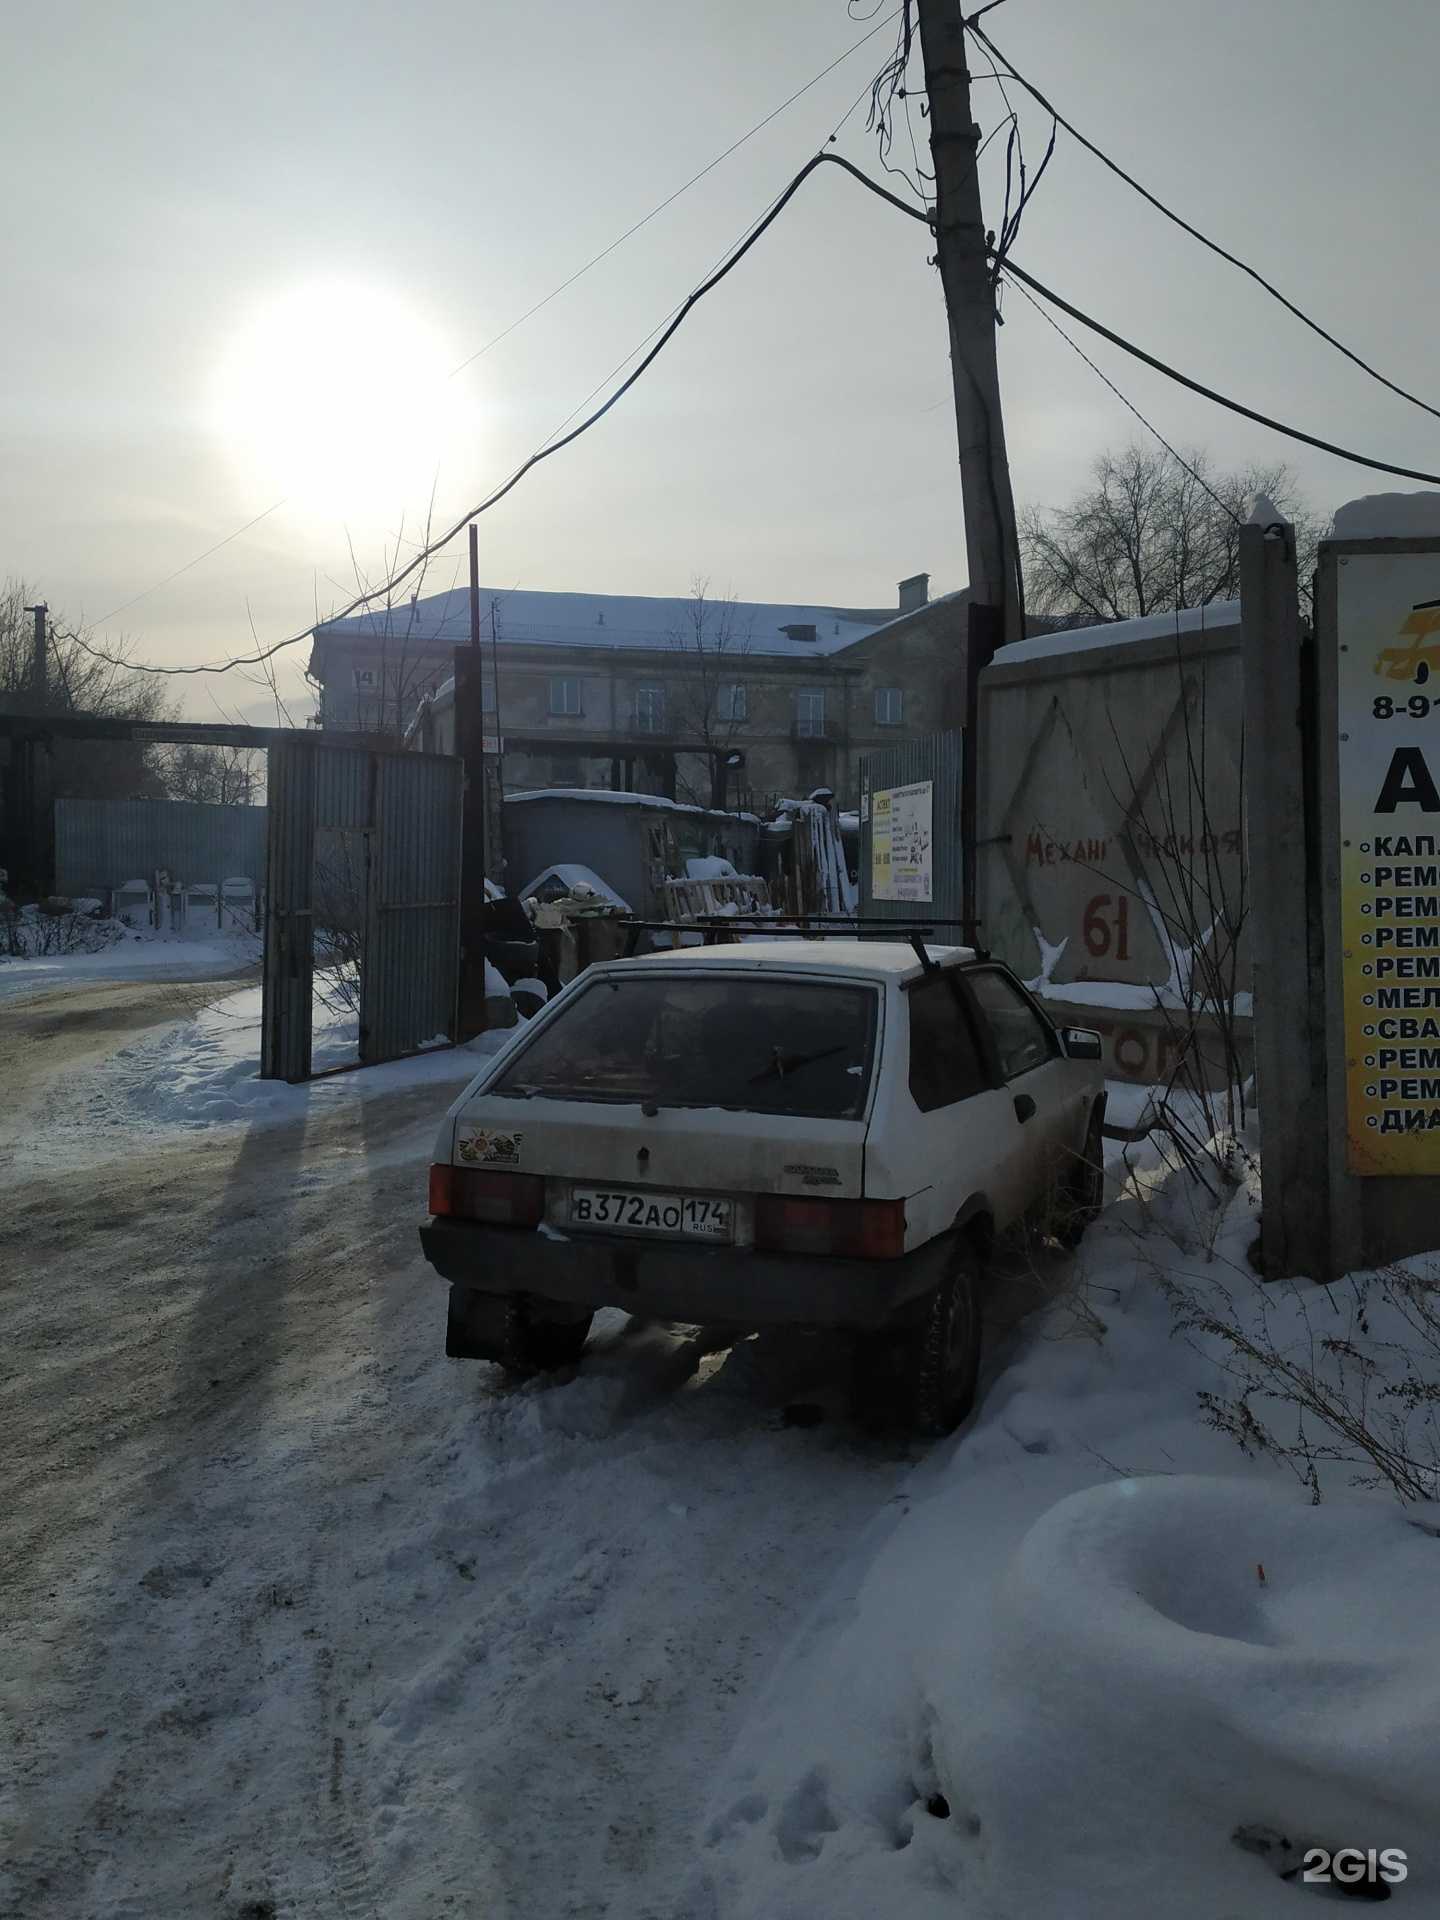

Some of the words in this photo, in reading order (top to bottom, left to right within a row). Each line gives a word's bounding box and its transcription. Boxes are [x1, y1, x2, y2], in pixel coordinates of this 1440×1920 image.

[1374, 747, 1440, 813] А
[1375, 866, 1440, 887] РЕМ
[1376, 896, 1440, 918] РЕМ
[1083, 894, 1131, 961] 61
[1376, 927, 1440, 947] РЕМ
[1376, 957, 1440, 978] РЕМ
[1377, 988, 1440, 1008] МЕЛ
[1378, 1018, 1440, 1039] СВА
[1379, 1048, 1440, 1069] РЕМ
[1380, 1079, 1440, 1099] РЕМ
[1380, 1109, 1440, 1133] ДИА
[686, 1200, 723, 1225] 174
[692, 1223, 714, 1233] RUS
